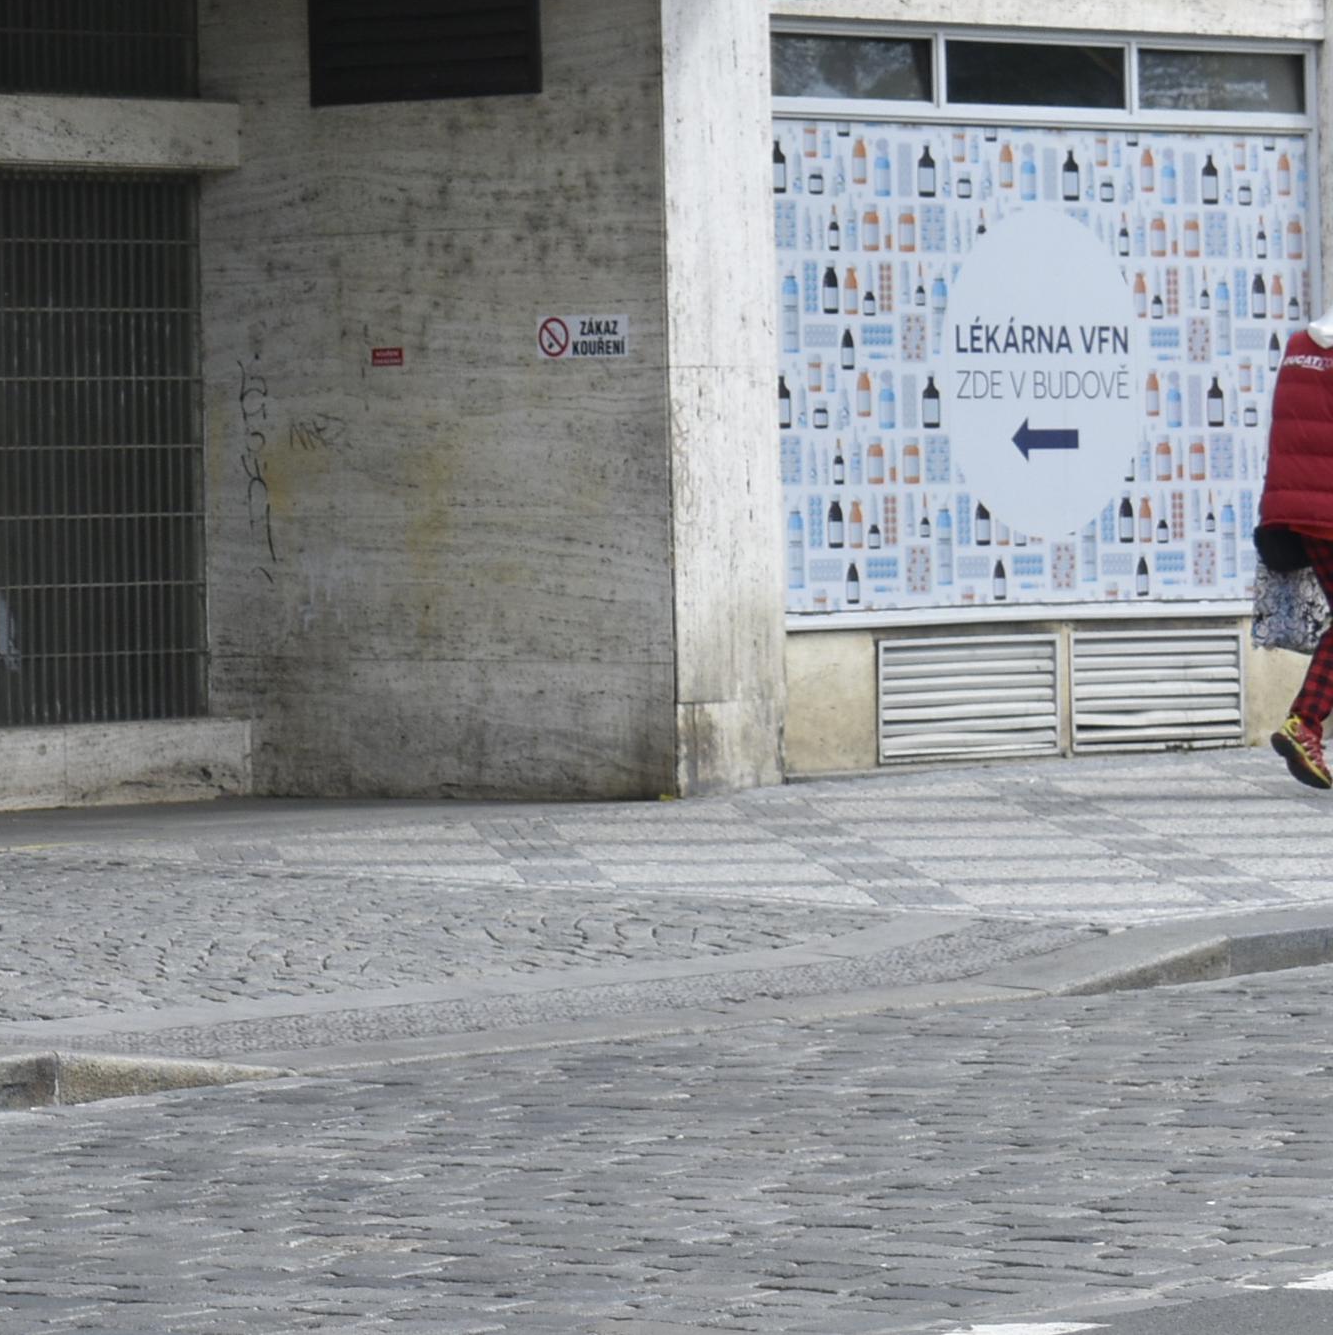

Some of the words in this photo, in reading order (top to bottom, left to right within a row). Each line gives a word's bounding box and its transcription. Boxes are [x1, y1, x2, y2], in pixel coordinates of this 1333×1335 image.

[579, 317, 618, 336] ZÁKAZ
[955, 316, 1073, 354] LÉKÁRNA
[1080, 325, 1129, 354] VFN
[572, 336, 625, 356] KOUŘENÍ
[956, 370, 1003, 399] ZDE
[1009, 370, 1026, 399] V
[1033, 364, 1130, 400] BUDOVĚ
